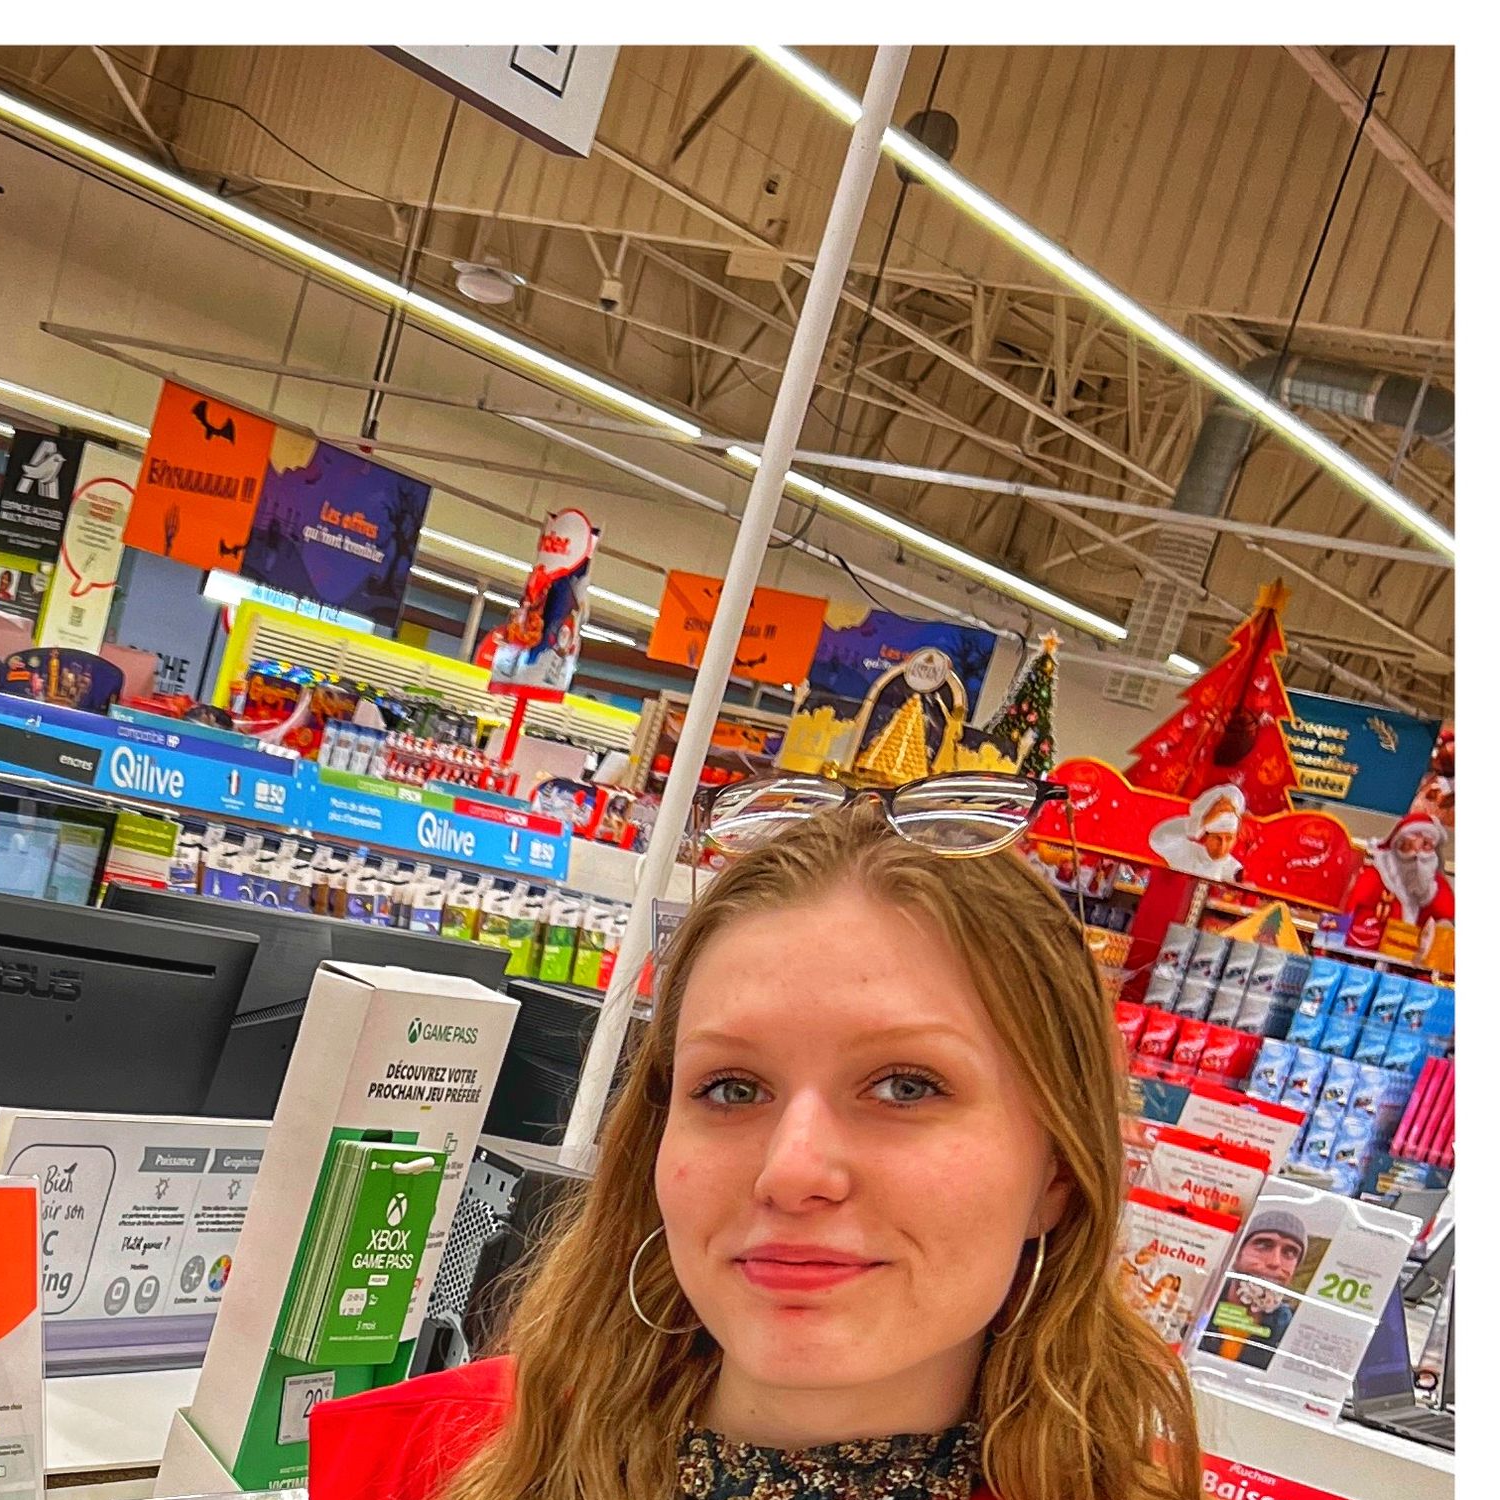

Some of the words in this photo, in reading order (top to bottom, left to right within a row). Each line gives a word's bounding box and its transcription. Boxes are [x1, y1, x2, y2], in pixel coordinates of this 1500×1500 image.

[319, 501, 341, 525] Les
[59, 753, 93, 771] encres
[110, 746, 185, 799] Qilive
[416, 811, 476, 857] Qilive
[423, 1023, 454, 1042] GAME
[453, 1025, 478, 1045] PASS
[386, 1061, 446, 1083] DÉCOUVREZ
[447, 1067, 478, 1084] VOTRE
[368, 1082, 424, 1101] PROCHAIN
[425, 1087, 443, 1102] JEU
[444, 1084, 482, 1103] PRÉFÉRÉ
[155, 1155, 197, 1167] Puissance
[1181, 1179, 1241, 1207] Auchan
[367, 1229, 411, 1251] XBOX
[352, 1253, 387, 1269] GAME
[385, 1254, 413, 1270] PASS
[1148, 1239, 1206, 1267] Auchan
[1318, 1273, 1372, 1304] 20€
